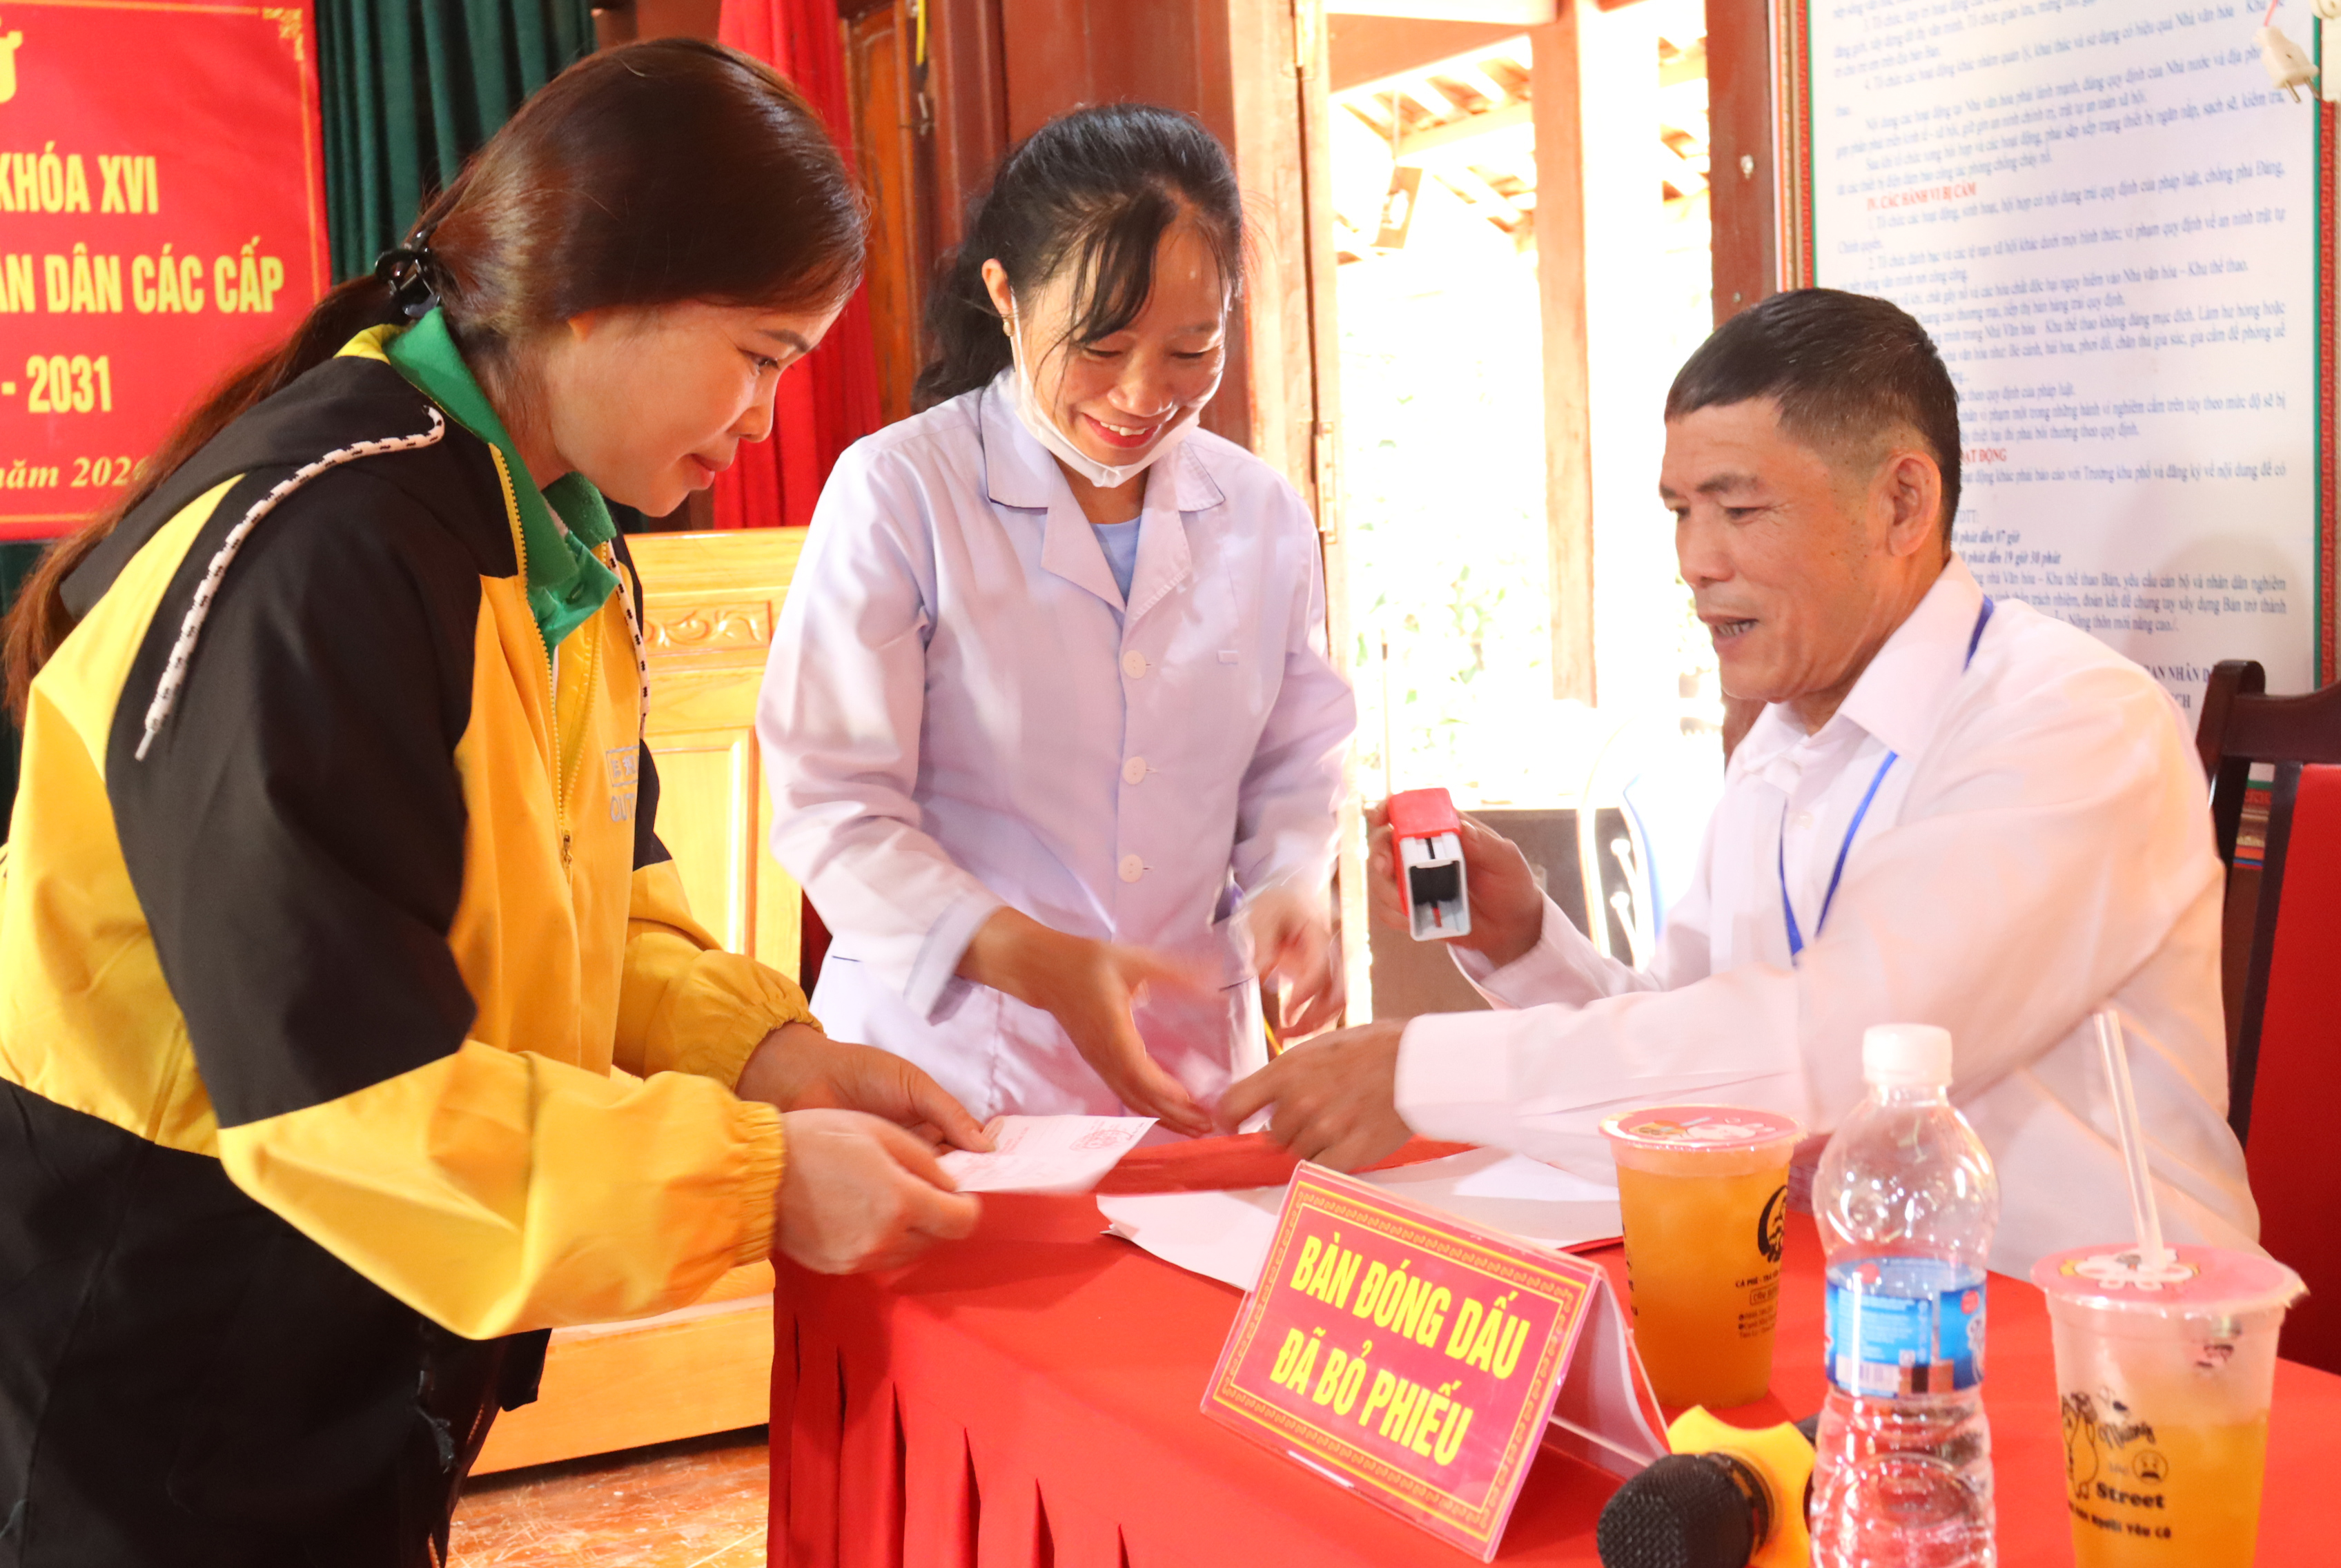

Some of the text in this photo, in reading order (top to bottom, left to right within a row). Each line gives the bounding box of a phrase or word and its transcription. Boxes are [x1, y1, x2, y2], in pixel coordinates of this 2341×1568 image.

[97, 155, 159, 214] XVI
[44, 242, 123, 313] DÂN
[132, 244, 205, 314] CÁC
[214, 236, 284, 314] CẤP
[26, 354, 112, 413] 2031
[1289, 1231, 1362, 1309] BÀN
[1352, 1256, 1454, 1348] ĐÓNG
[1444, 1289, 1531, 1380] DẤU
[1269, 1327, 1474, 1467] ĐÃ BỎ PHIẾU
[2096, 1481, 2165, 1509] Street
